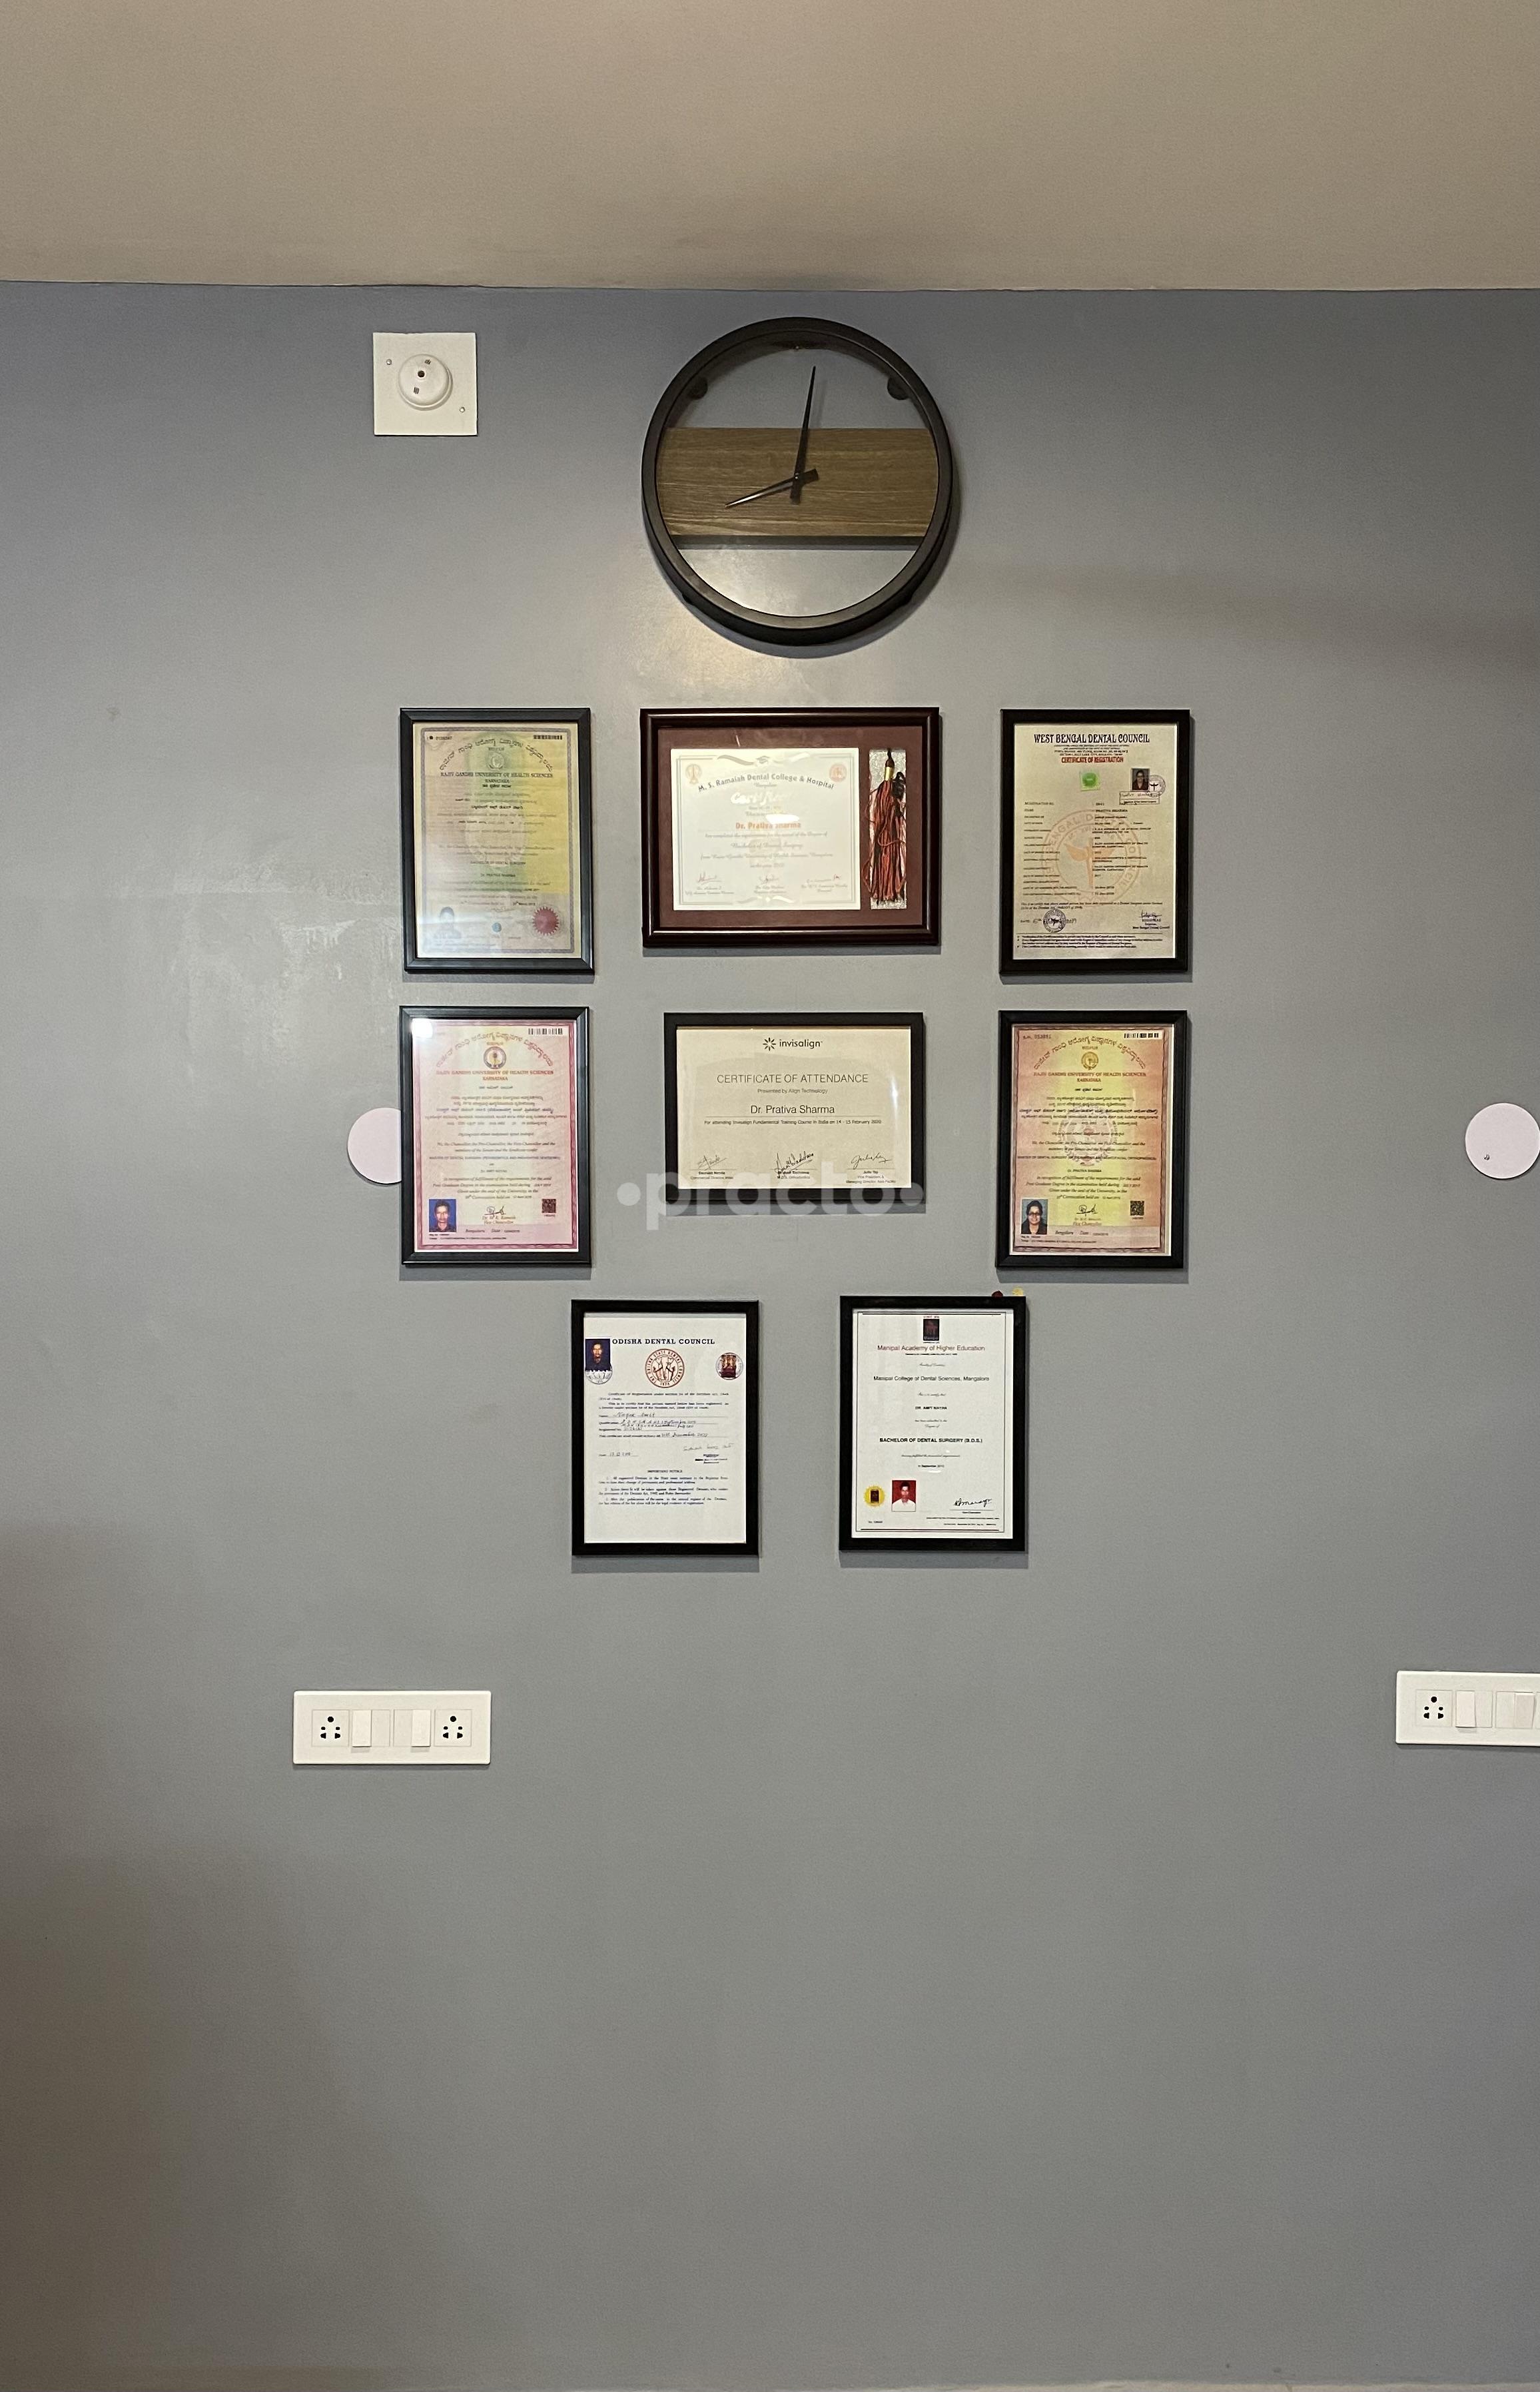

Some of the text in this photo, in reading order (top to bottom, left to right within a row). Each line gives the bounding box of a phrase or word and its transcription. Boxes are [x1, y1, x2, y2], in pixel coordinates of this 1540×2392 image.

[1034, 734, 1150, 743] WEST BENGAL DENTAL COUNCIL
[716, 776, 745, 786] Ramaiah
[771, 773, 797, 782] College
[807, 777, 834, 789] Hospital
[779, 1039, 821, 1049] invisalign
[717, 1074, 869, 1083] CERTIFICATE OF ATTENDANCE
